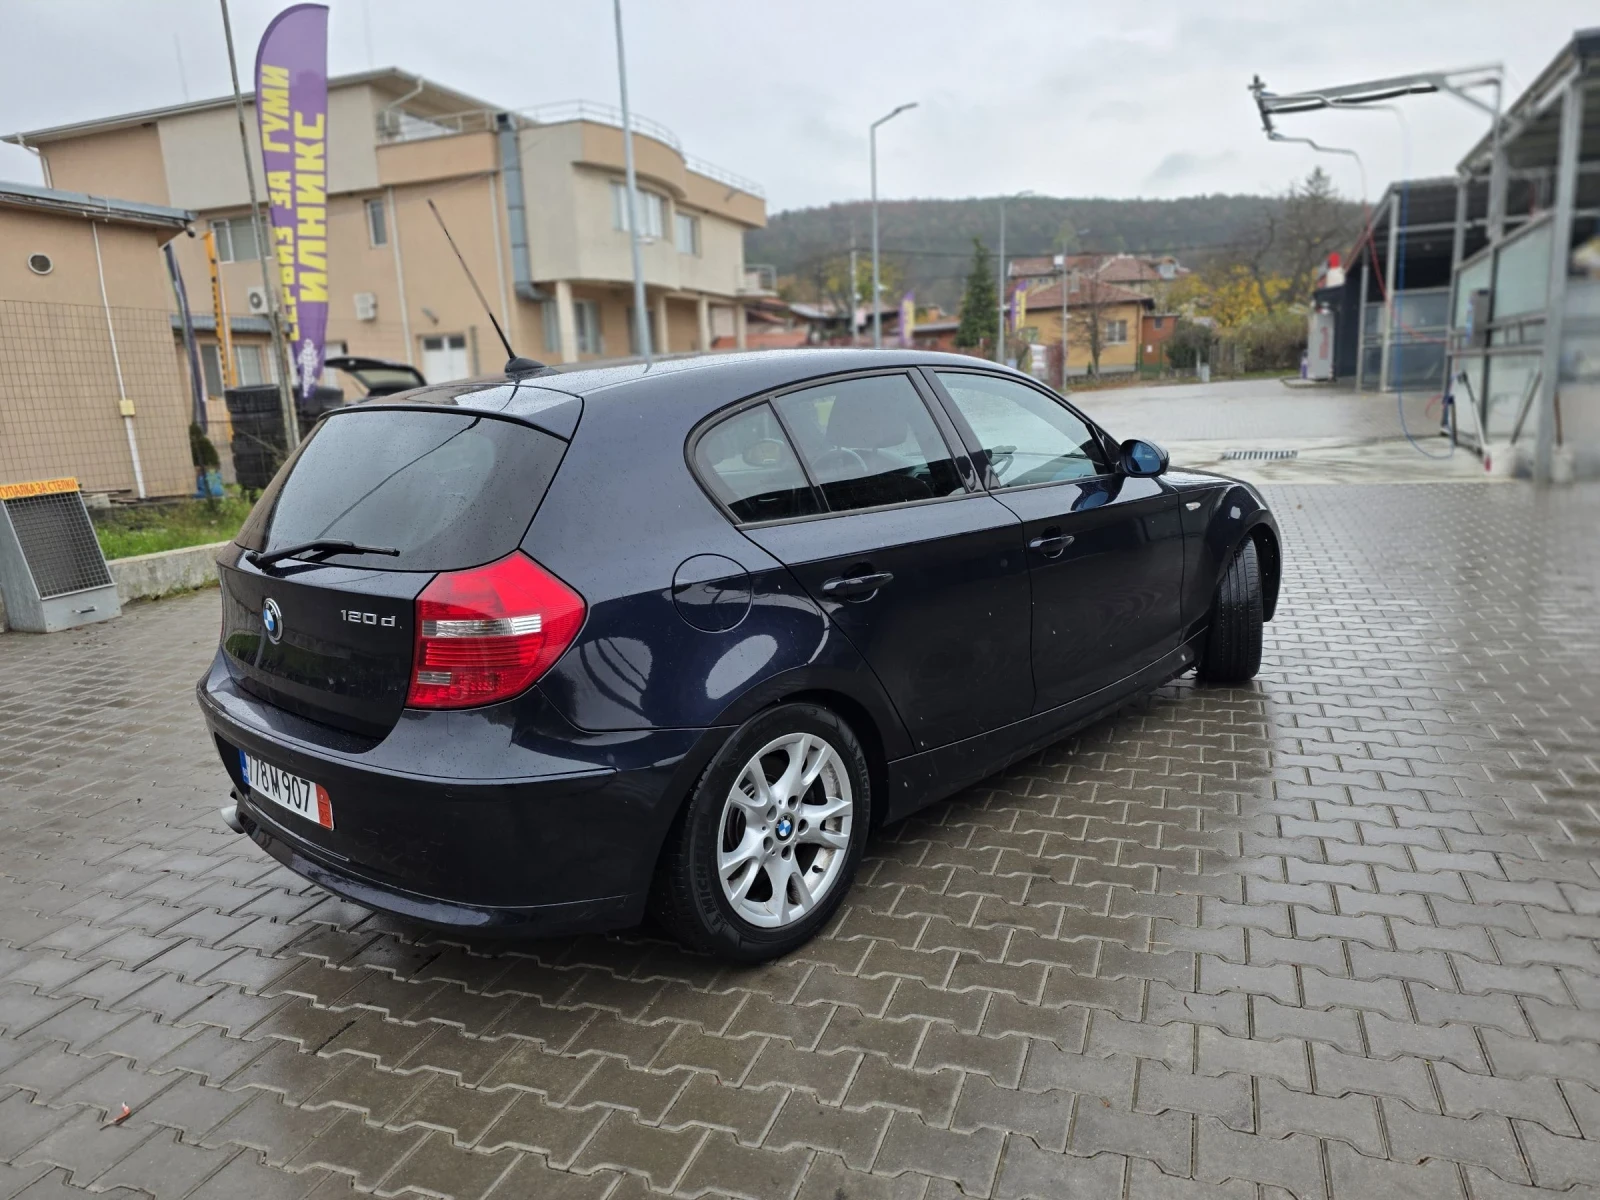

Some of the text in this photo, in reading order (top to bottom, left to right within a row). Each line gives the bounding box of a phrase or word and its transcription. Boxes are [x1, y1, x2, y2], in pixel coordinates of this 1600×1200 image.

[261, 64, 290, 153] ГУМИ
[267, 171, 292, 210] ЗА
[294, 111, 327, 302] ИЛНИКС
